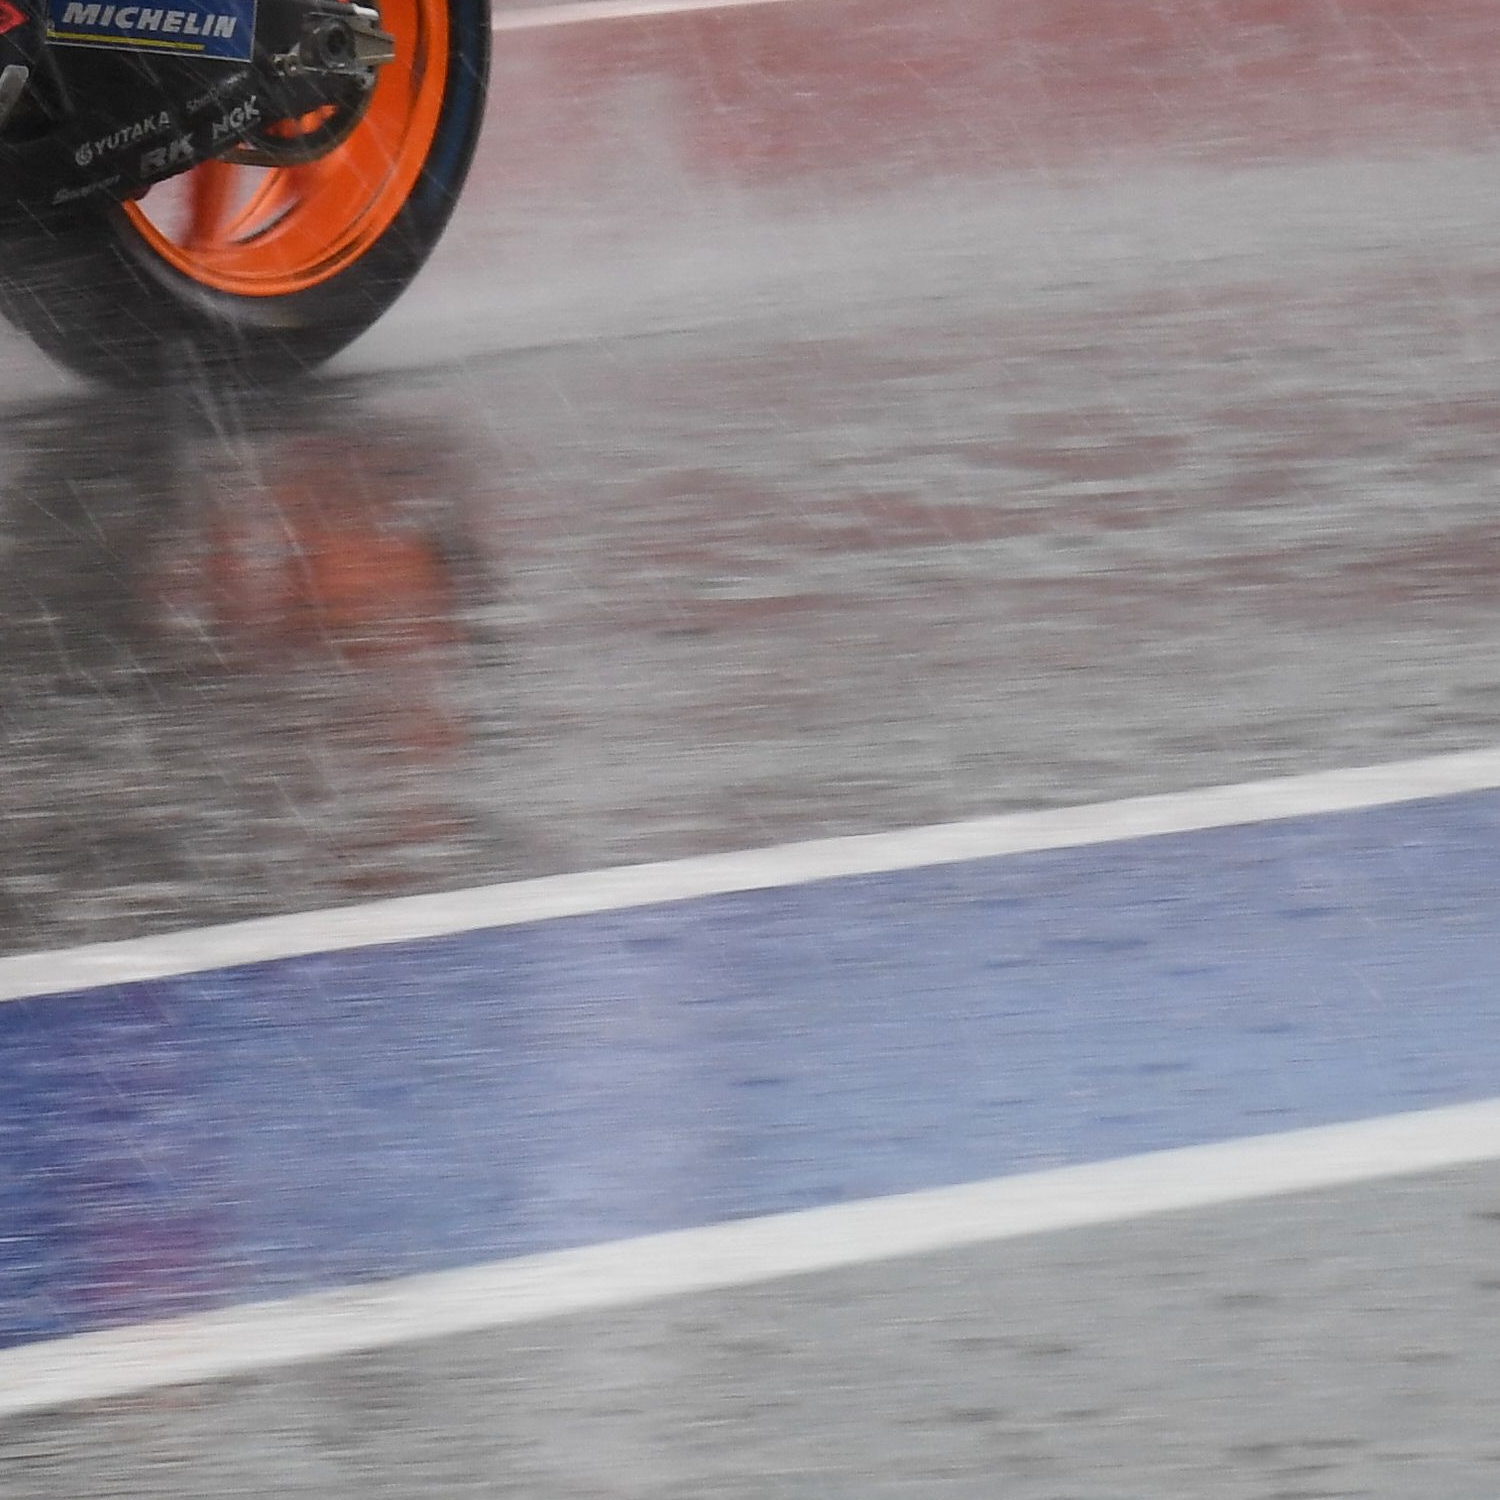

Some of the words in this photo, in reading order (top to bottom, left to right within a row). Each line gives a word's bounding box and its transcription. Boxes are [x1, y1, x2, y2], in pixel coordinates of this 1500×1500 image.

[62, 2, 238, 39] MICHELIN
[95, 110, 171, 155] YUTAKA
[211, 94, 260, 140] NGK
[140, 133, 194, 178] RK
